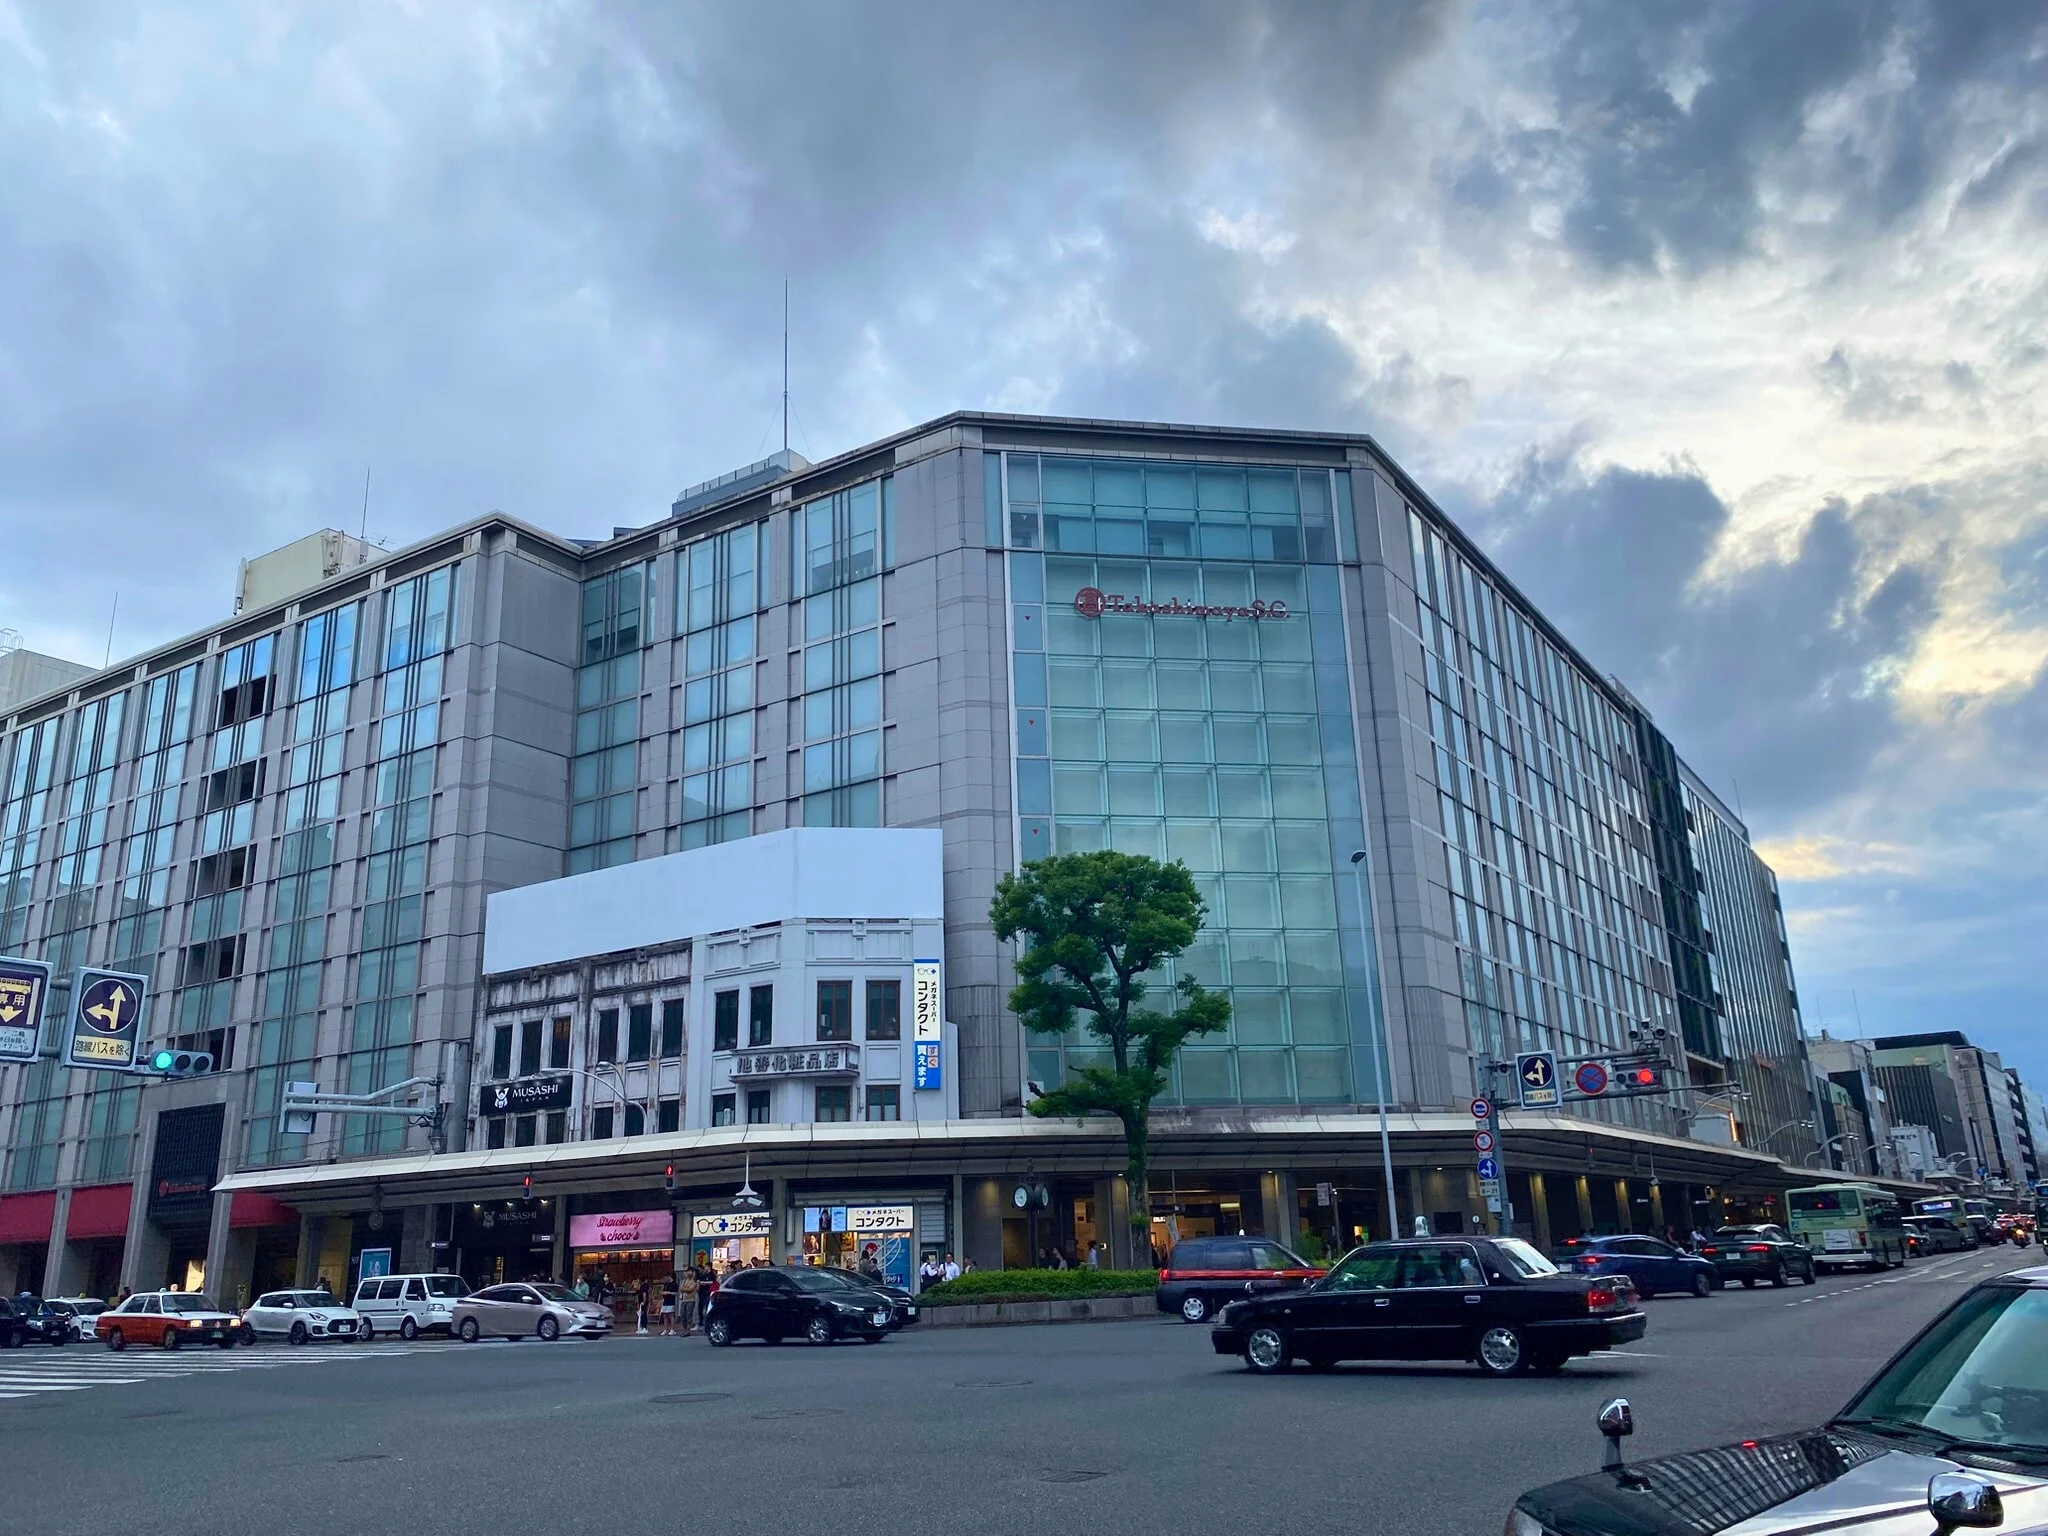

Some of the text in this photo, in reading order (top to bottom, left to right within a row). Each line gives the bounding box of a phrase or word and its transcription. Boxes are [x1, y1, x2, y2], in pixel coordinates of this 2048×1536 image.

[917, 981, 929, 1036] コンタクト
[75, 1040, 130, 1056] 路線バスを除く
[928, 1045, 938, 1067] すぐ
[917, 1045, 927, 1087] 買えます
[512, 1084, 559, 1098] MUSASHI
[498, 1211, 537, 1221] MUSASHI
[597, 1214, 642, 1230] Strawberry
[856, 1216, 905, 1227] コンタクト
[606, 1229, 632, 1241] choco
